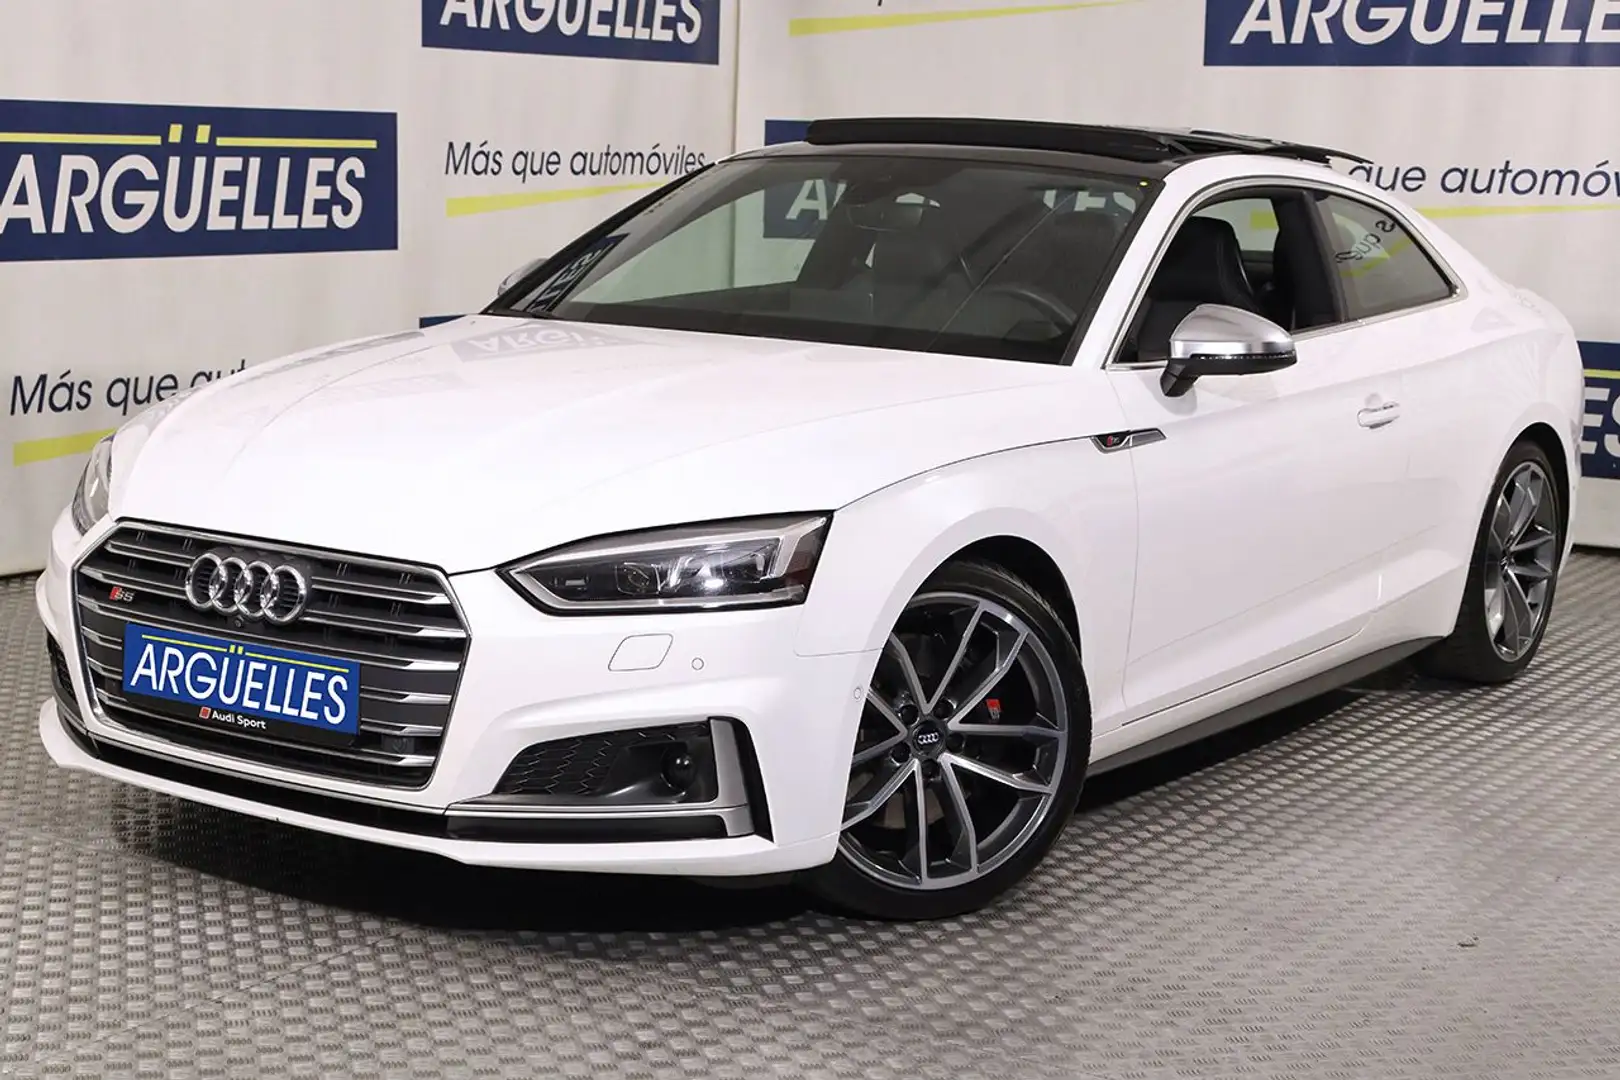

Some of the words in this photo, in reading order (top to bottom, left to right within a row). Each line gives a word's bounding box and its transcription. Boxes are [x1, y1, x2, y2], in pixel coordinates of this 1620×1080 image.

[0, 124, 366, 233] ARGÜELLES
[445, 140, 502, 176] Más
[511, 149, 561, 183] que
[570, 143, 706, 176] automóviles
[10, 369, 92, 416] Más
[106, 373, 178, 416] que
[130, 643, 348, 725] ARGÜELLES
[211, 710, 235, 723] Audi
[237, 715, 266, 730] Sport
